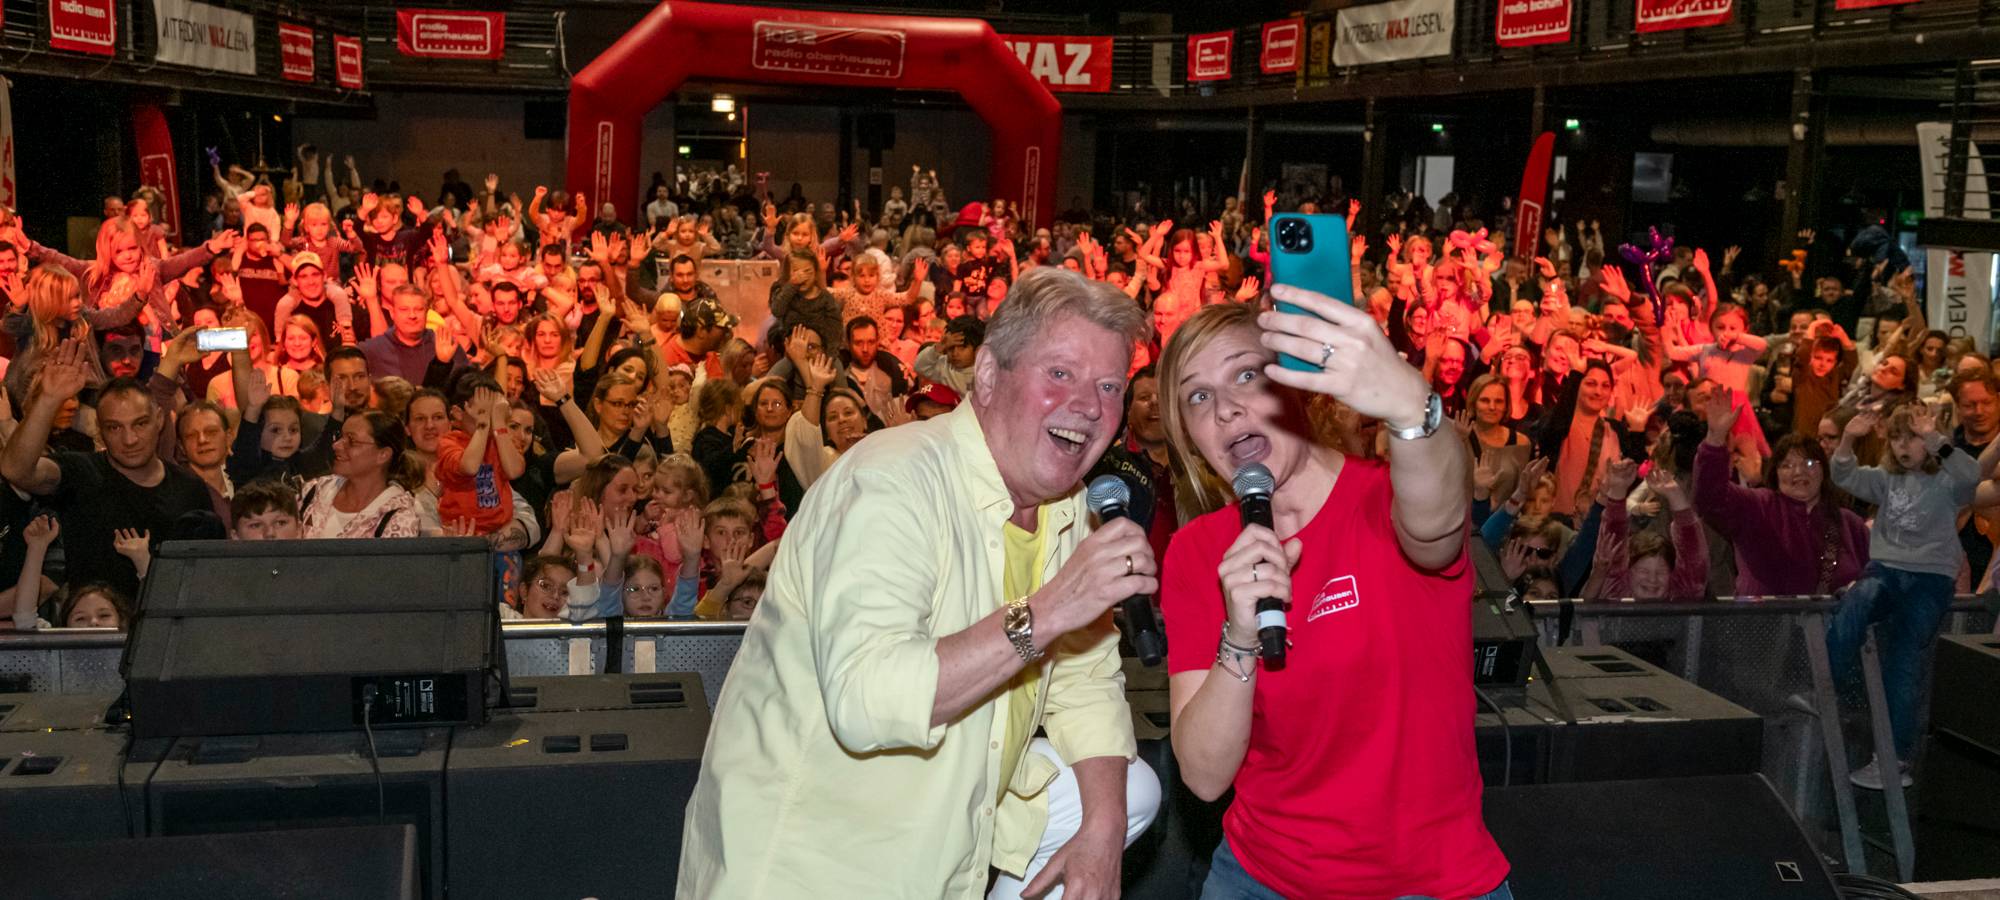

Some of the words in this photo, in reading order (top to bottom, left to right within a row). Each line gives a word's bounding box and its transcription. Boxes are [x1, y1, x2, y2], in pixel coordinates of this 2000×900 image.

[420, 23, 448, 31] radio
[765, 49, 802, 59] radio
[806, 51, 892, 66] oberhausen
